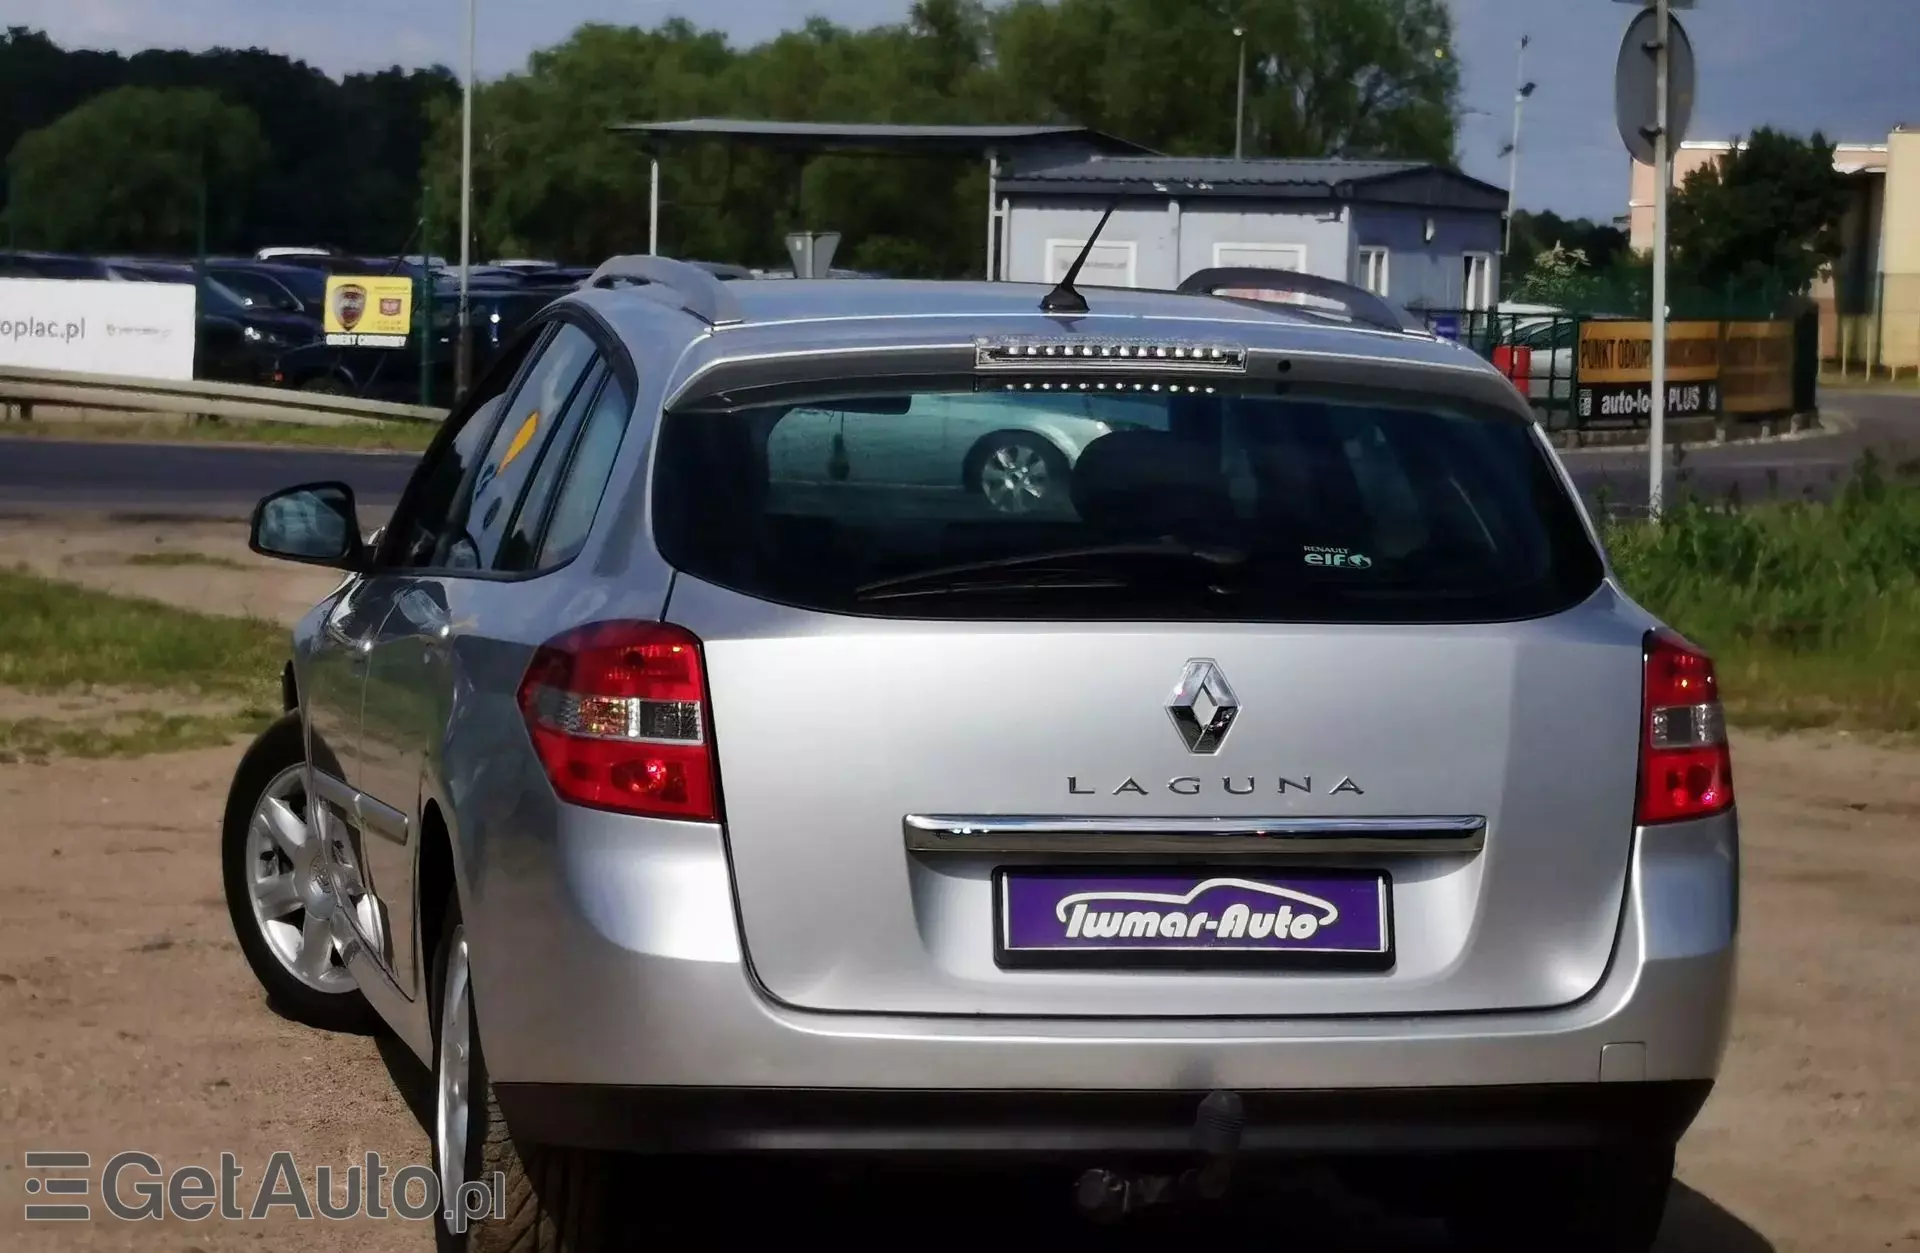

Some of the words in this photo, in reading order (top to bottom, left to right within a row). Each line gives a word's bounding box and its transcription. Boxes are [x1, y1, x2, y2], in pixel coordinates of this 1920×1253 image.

[1581, 339, 1615, 369] PUNKT
[1668, 386, 1700, 412] PLUS
[1303, 545, 1350, 554] RENAULT
[1304, 553, 1346, 566] elf
[1067, 776, 1365, 795] LAGUNA
